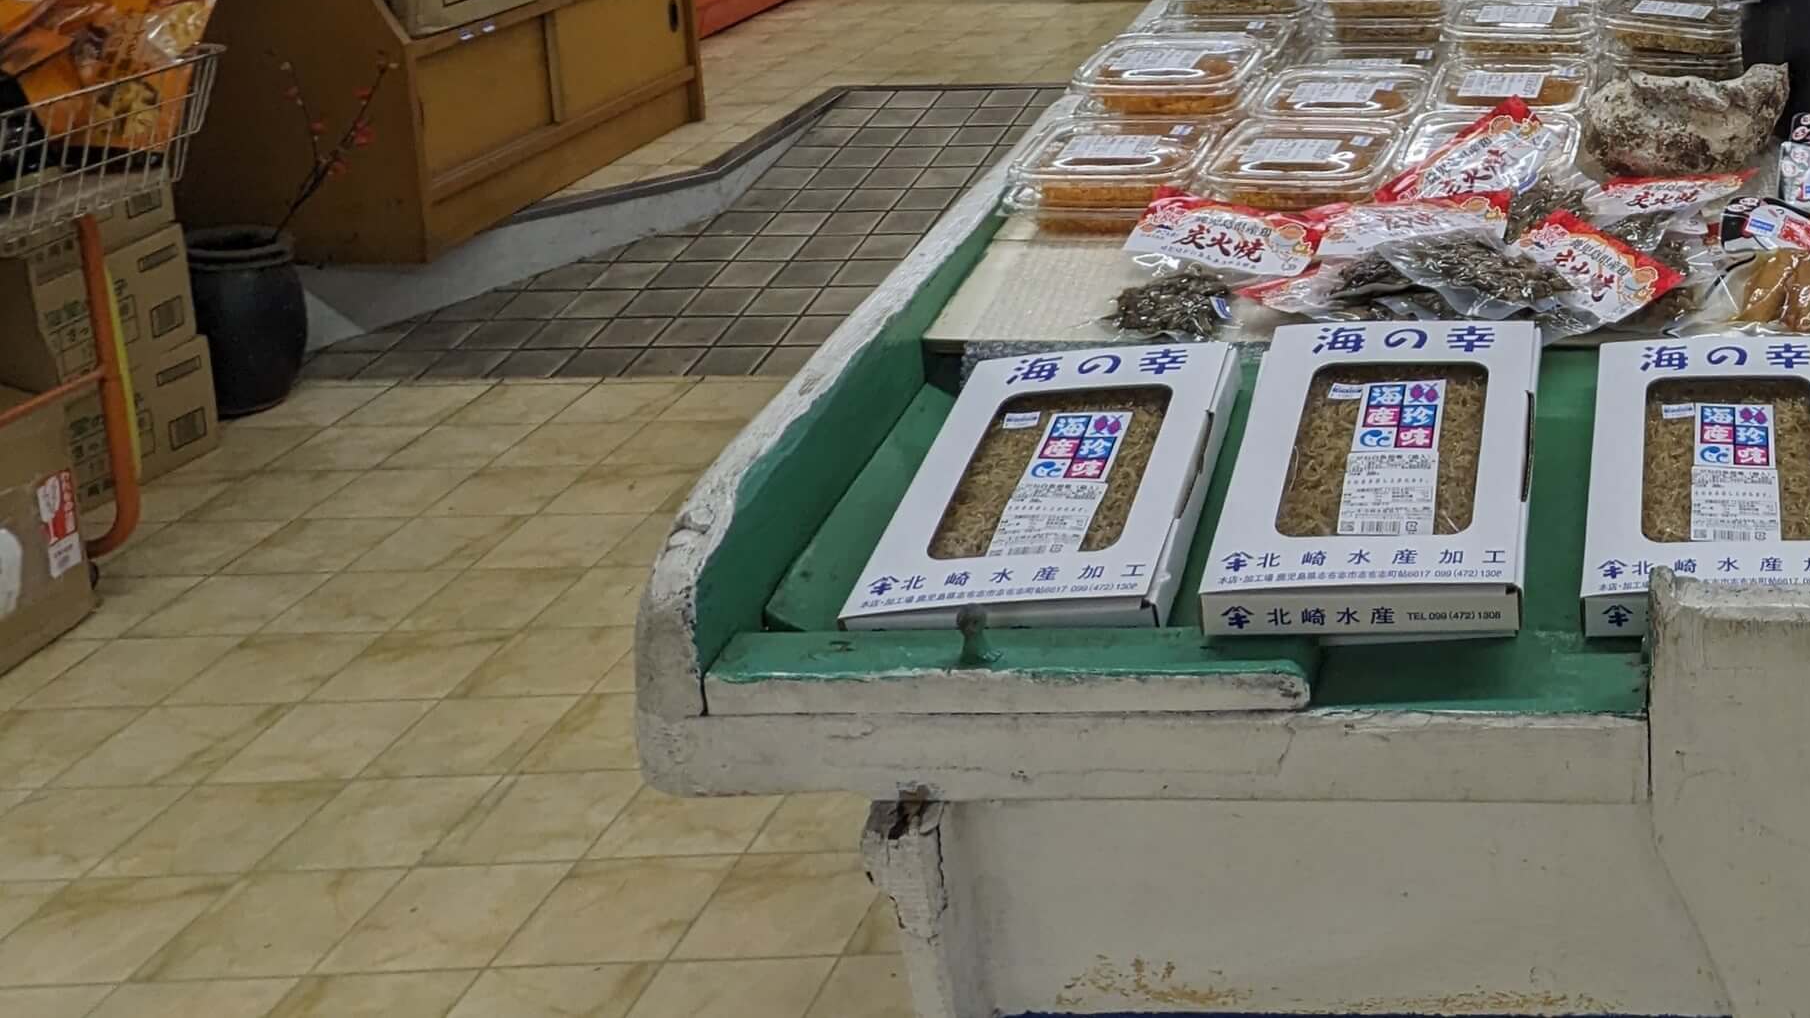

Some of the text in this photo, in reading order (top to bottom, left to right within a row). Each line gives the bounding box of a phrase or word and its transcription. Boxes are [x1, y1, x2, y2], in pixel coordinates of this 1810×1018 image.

[1171, 224, 1265, 262] 炭火焼
[1312, 326, 1495, 354] 海の幸
[1005, 348, 1189, 385] 海の幸
[1639, 343, 1810, 372] 海の幸
[1256, 549, 1506, 568] 北崎水産加工
[900, 563, 1146, 591] 北崎水産加工
[1267, 606, 1395, 627] 北崎水産
